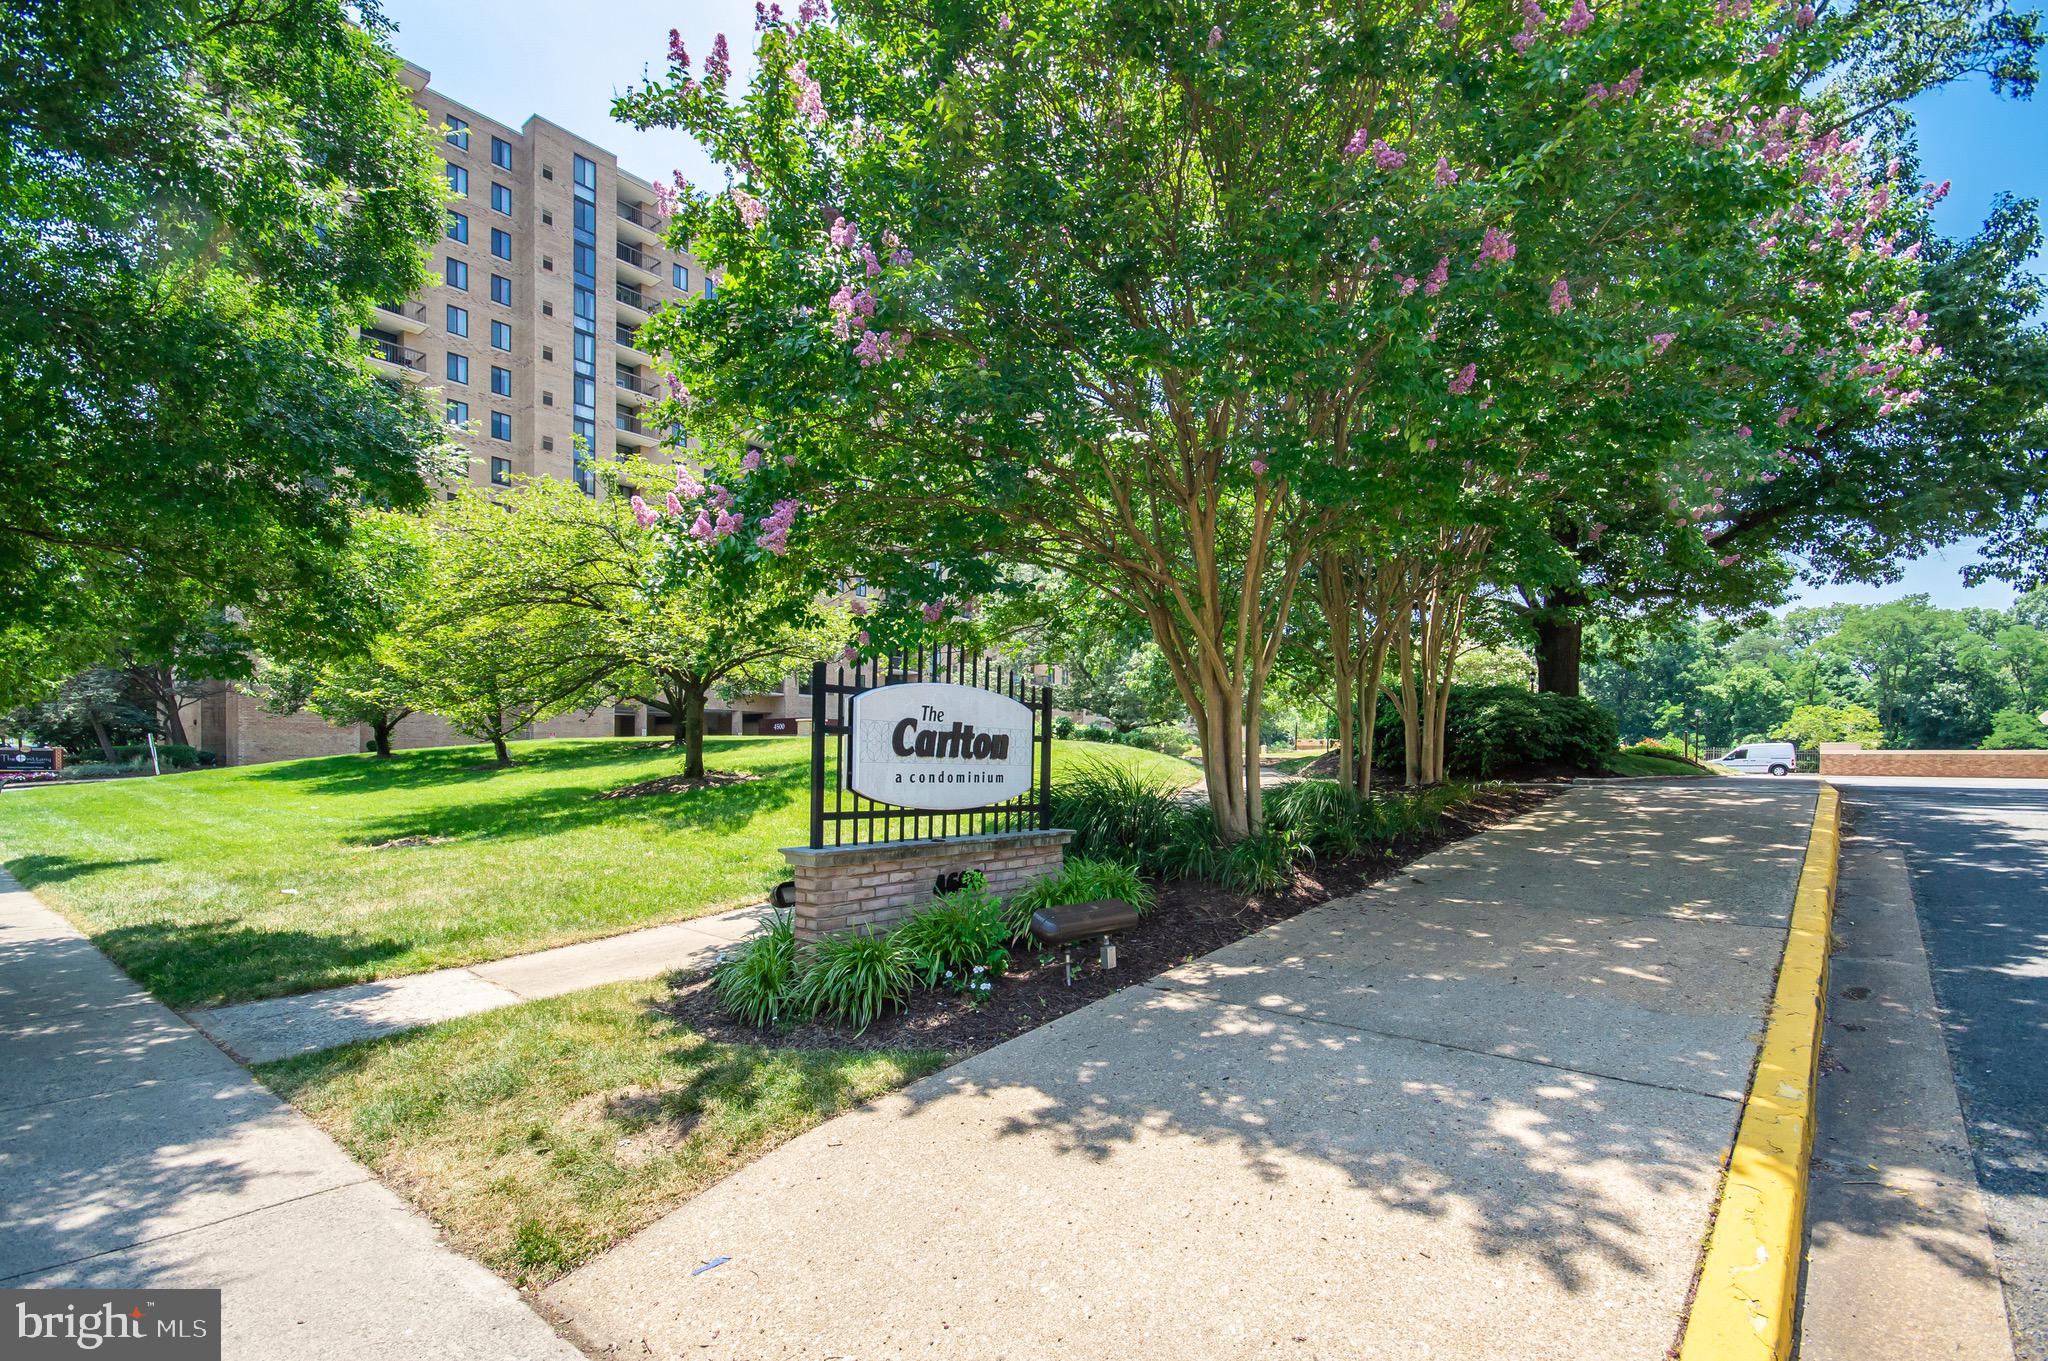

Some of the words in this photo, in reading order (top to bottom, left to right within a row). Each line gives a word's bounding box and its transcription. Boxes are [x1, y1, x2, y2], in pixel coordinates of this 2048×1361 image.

[922, 705, 945, 722] The
[892, 717, 1010, 760] Carlton
[895, 773, 902, 783] a
[909, 771, 1005, 783] condominium
